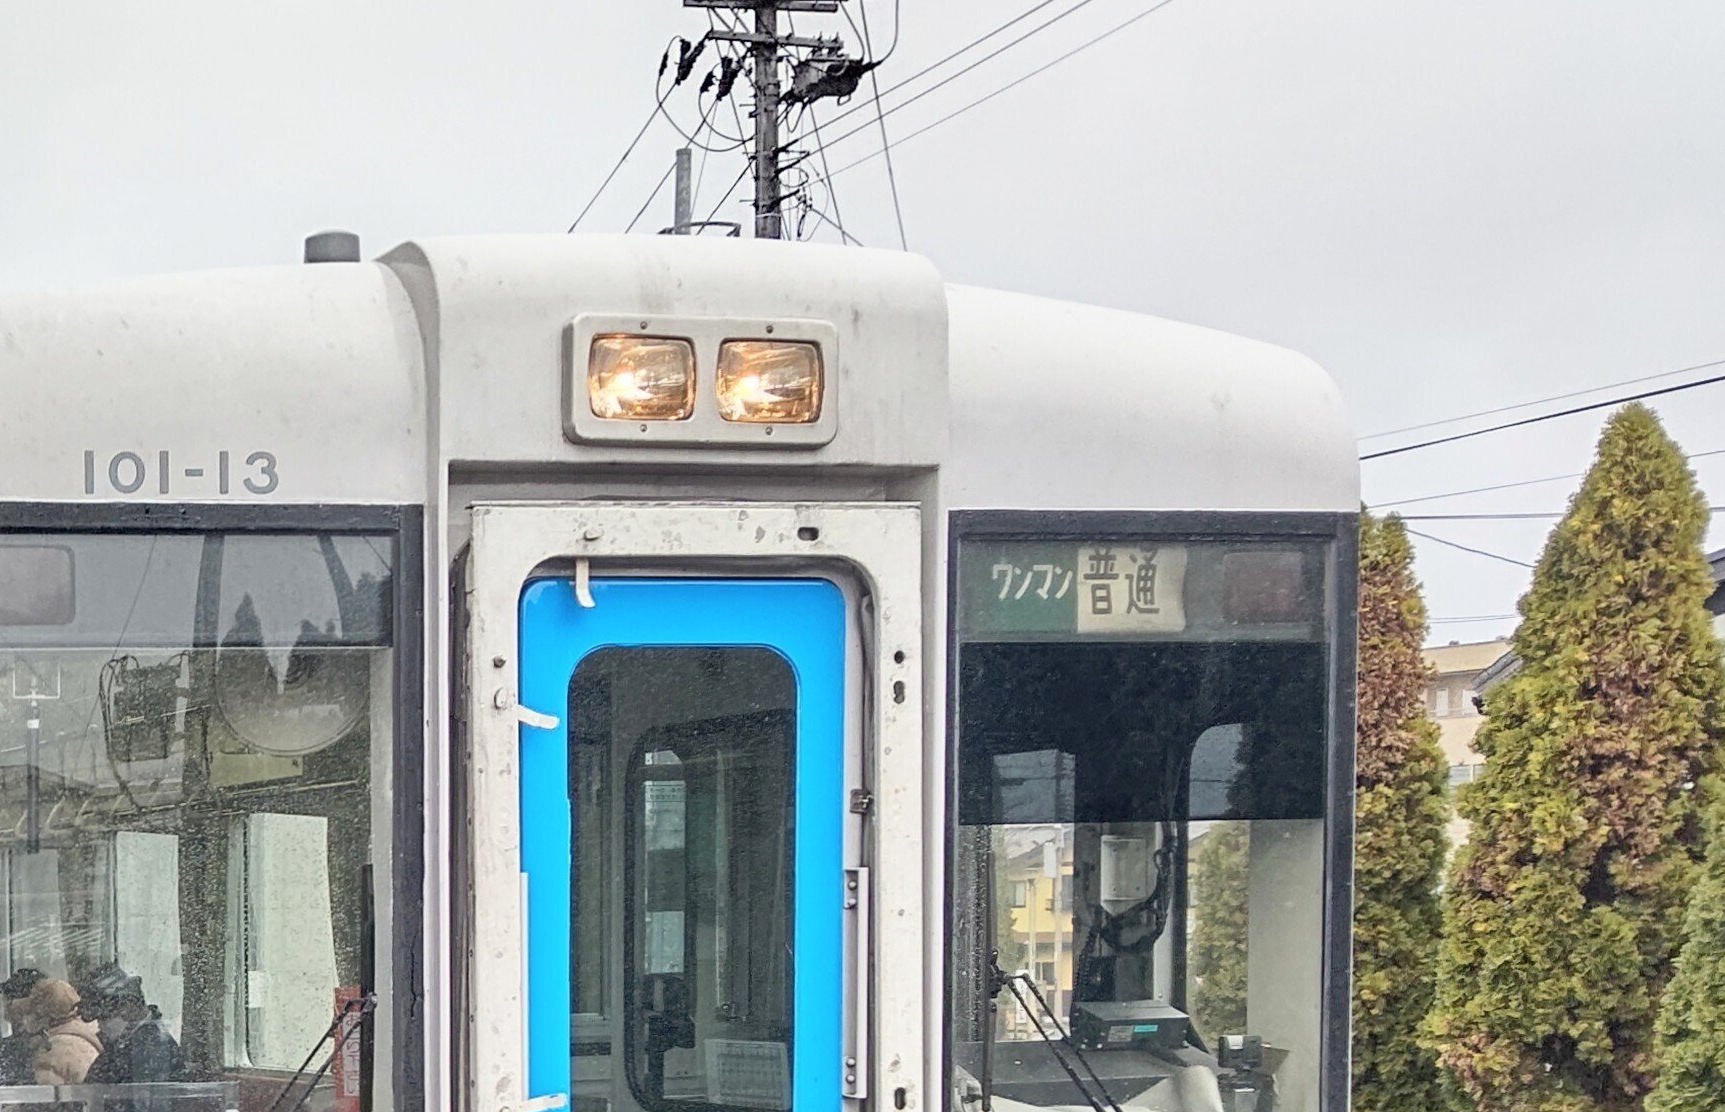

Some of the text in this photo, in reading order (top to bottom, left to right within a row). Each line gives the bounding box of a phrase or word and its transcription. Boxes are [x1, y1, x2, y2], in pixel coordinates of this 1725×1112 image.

[84, 450, 279, 495] 101-13
[992, 548, 1160, 615] ワンマン 普通
